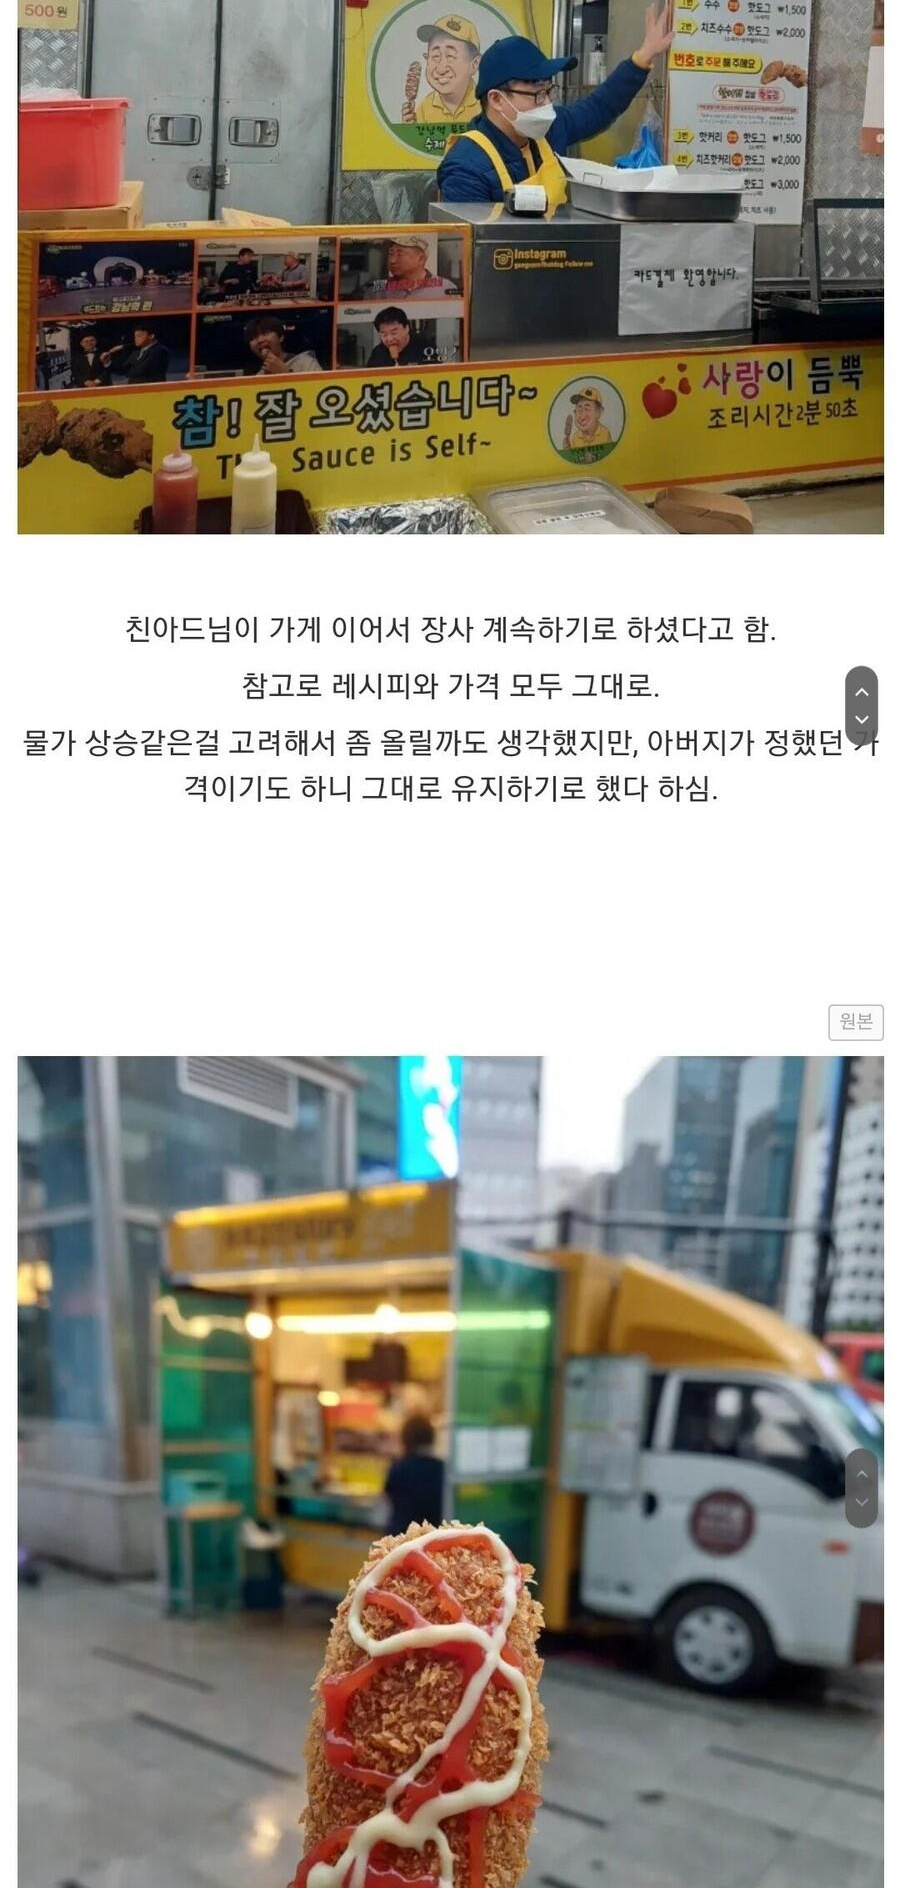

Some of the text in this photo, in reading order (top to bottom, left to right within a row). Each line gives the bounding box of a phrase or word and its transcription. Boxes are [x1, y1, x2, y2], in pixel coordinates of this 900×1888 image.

[24, 3, 67, 19] 500 원
[747, 1, 771, 14] 핫도그
[680, 21, 693, 31] 2번
[746, 25, 770, 37] 핫도그
[673, 52, 705, 68] 번호로
[705, 56, 721, 68] 주문
[699, 131, 723, 143] 핫커리
[743, 132, 767, 144] 핫도그
[744, 154, 766, 166] 핫도그
[743, 178, 765, 190] 핫도그
[514, 248, 567, 261] Instagram
[634, 267, 740, 288] 카드결제 환영합니다.
[702, 354, 864, 401] 사랑이 듬뿍
[173, 375, 538, 449] 참! 잘 오셨습니다~
[825, 397, 859, 419] 50초
[292, 432, 491, 473] Sauce is Self~
[125, 615, 776, 644] 친아드님이 가게 이어서 장사 계속하기로 하셨다고 함.
